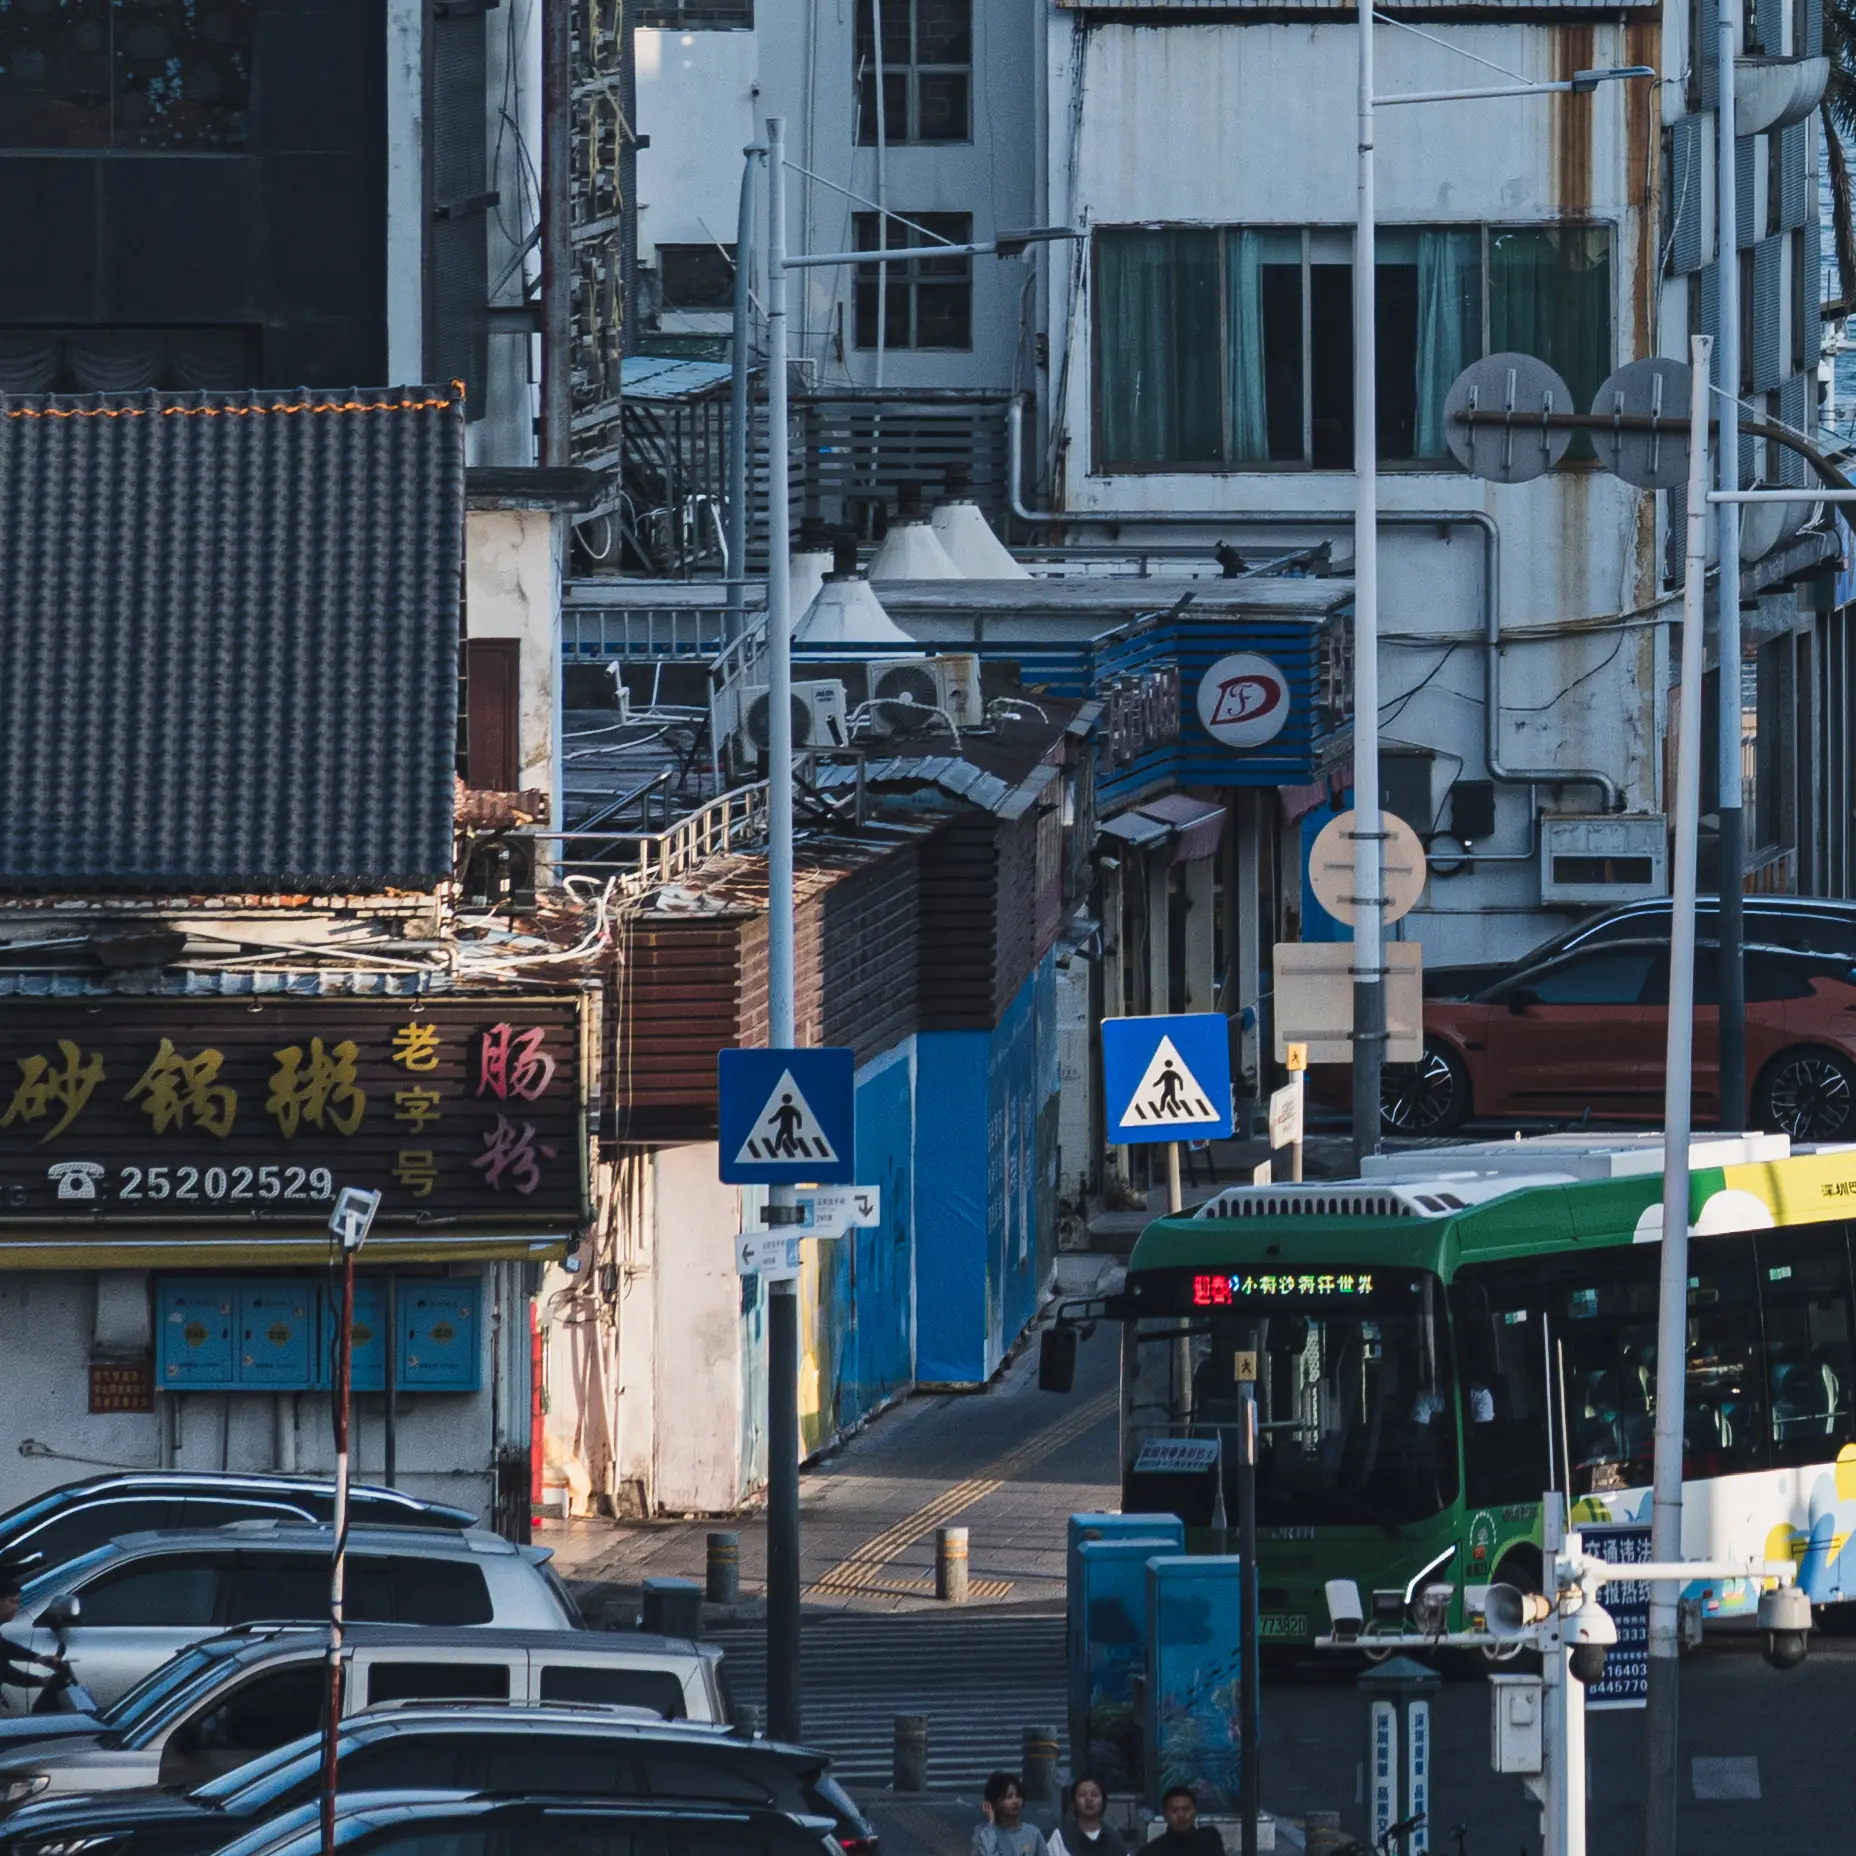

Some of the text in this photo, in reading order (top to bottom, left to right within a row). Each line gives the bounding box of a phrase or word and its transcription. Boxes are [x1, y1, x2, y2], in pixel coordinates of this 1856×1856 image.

[0, 1037, 366, 1144] 砂锅粥
[391, 1022, 442, 1199] 老字号
[472, 1022, 557, 1194] 肠粉
[119, 1166, 334, 1200] 25202529
[1585, 1538, 1652, 1564] 交通违法
[1597, 1580, 1650, 1605] 报热线
